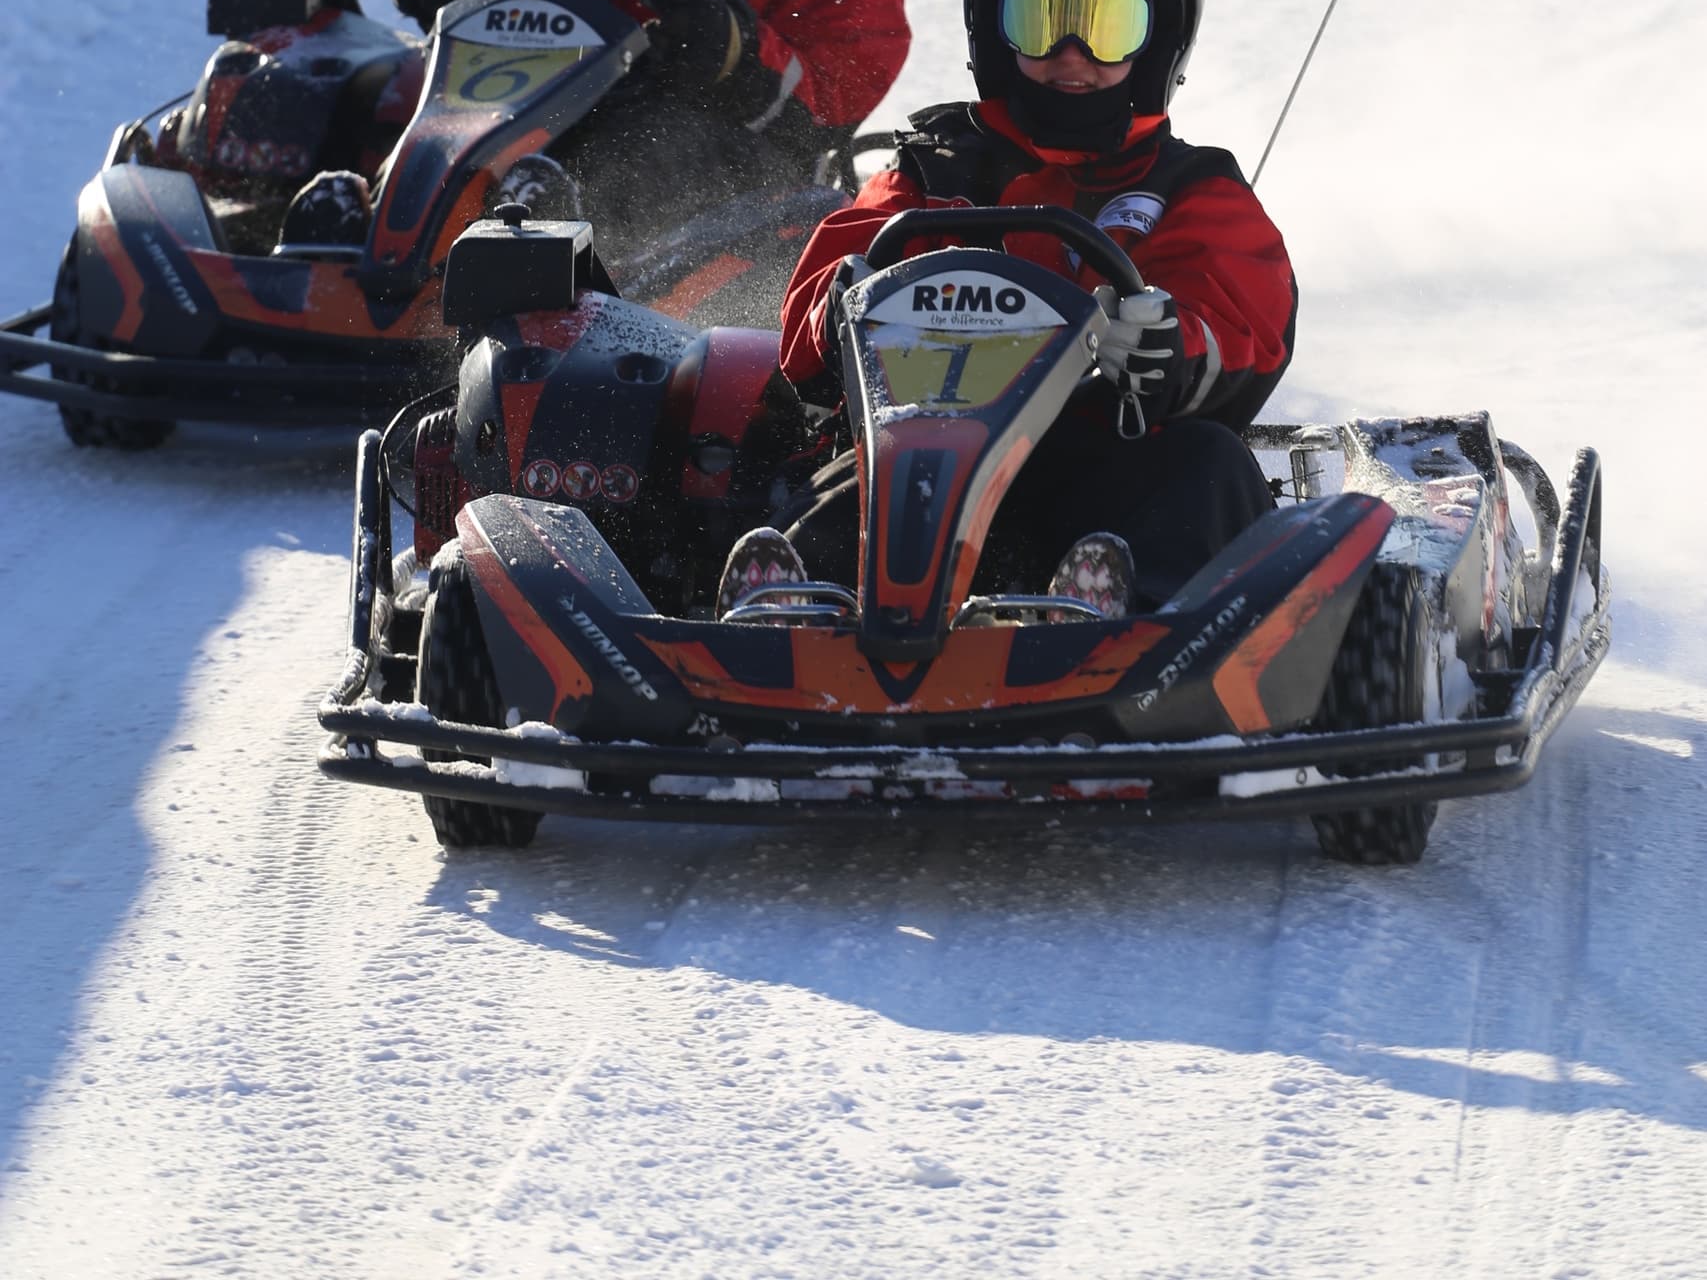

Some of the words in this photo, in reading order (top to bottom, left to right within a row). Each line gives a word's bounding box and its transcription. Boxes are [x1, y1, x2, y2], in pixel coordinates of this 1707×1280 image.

[459, 53, 549, 102] 6
[930, 314, 947, 325] the
[950, 312, 1004, 326] difference
[920, 342, 974, 404] 1
[570, 610, 658, 701] DUNLOP
[1158, 595, 1247, 692] DUNLOP
